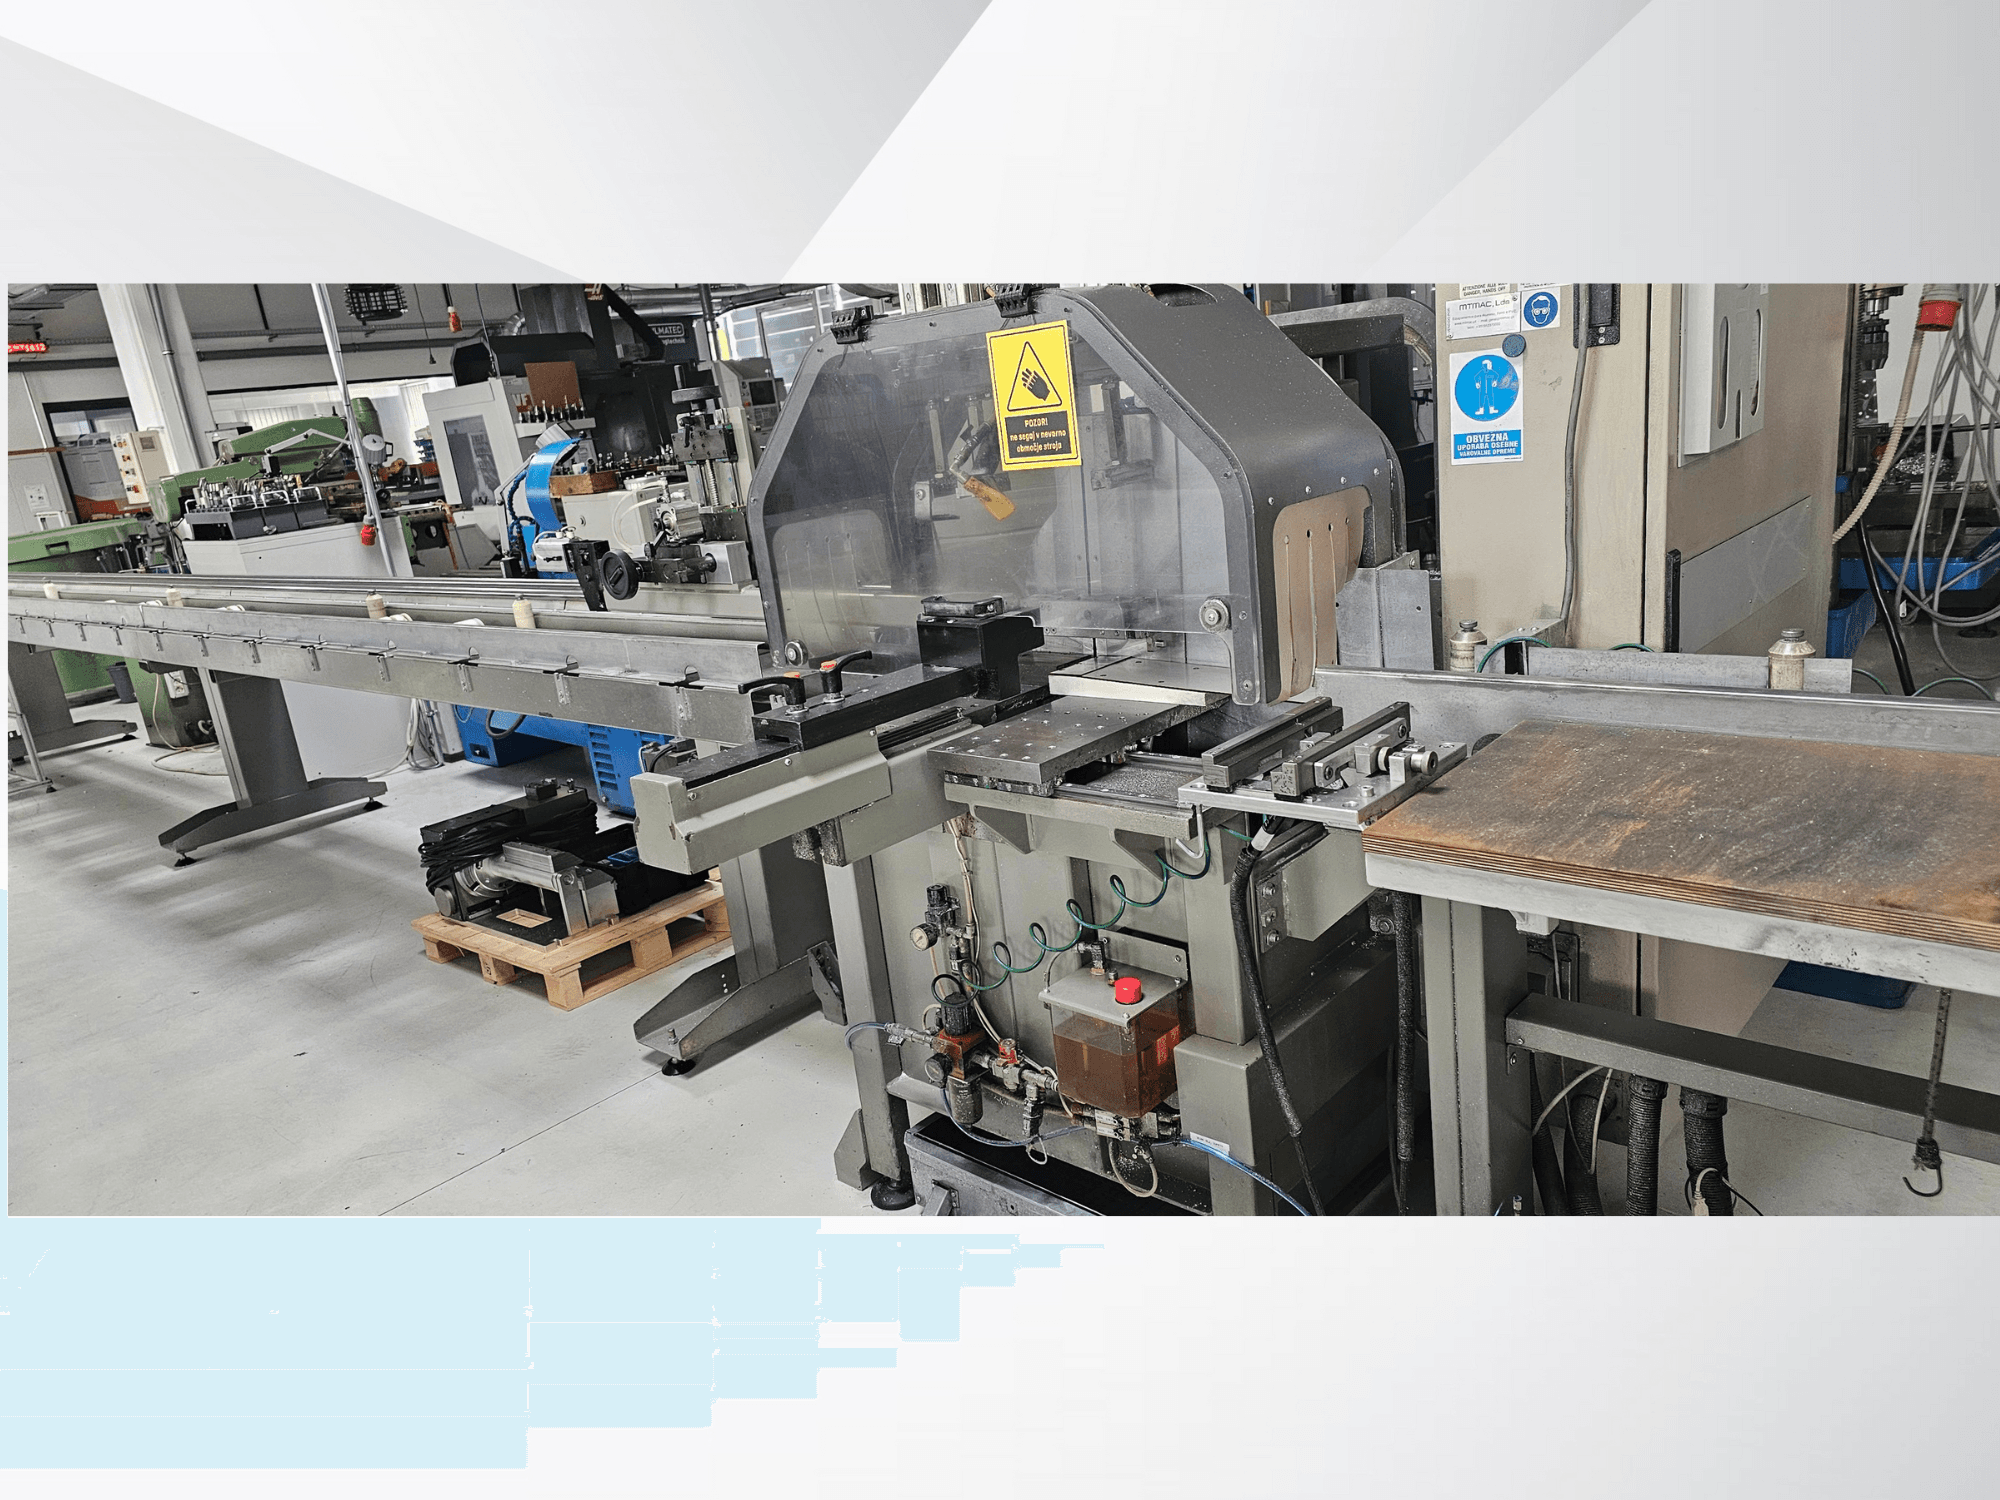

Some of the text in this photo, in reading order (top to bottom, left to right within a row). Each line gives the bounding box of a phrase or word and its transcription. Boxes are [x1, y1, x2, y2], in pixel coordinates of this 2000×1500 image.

[1024, 417, 1048, 427] POZOR!
[1019, 431, 1035, 441] segaj
[1040, 430, 1066, 438] nevarno
[1466, 432, 1509, 443] OBVEZNA
[1043, 440, 1062, 451] stroja
[1457, 441, 1519, 451] UPORABA OSEBNE
